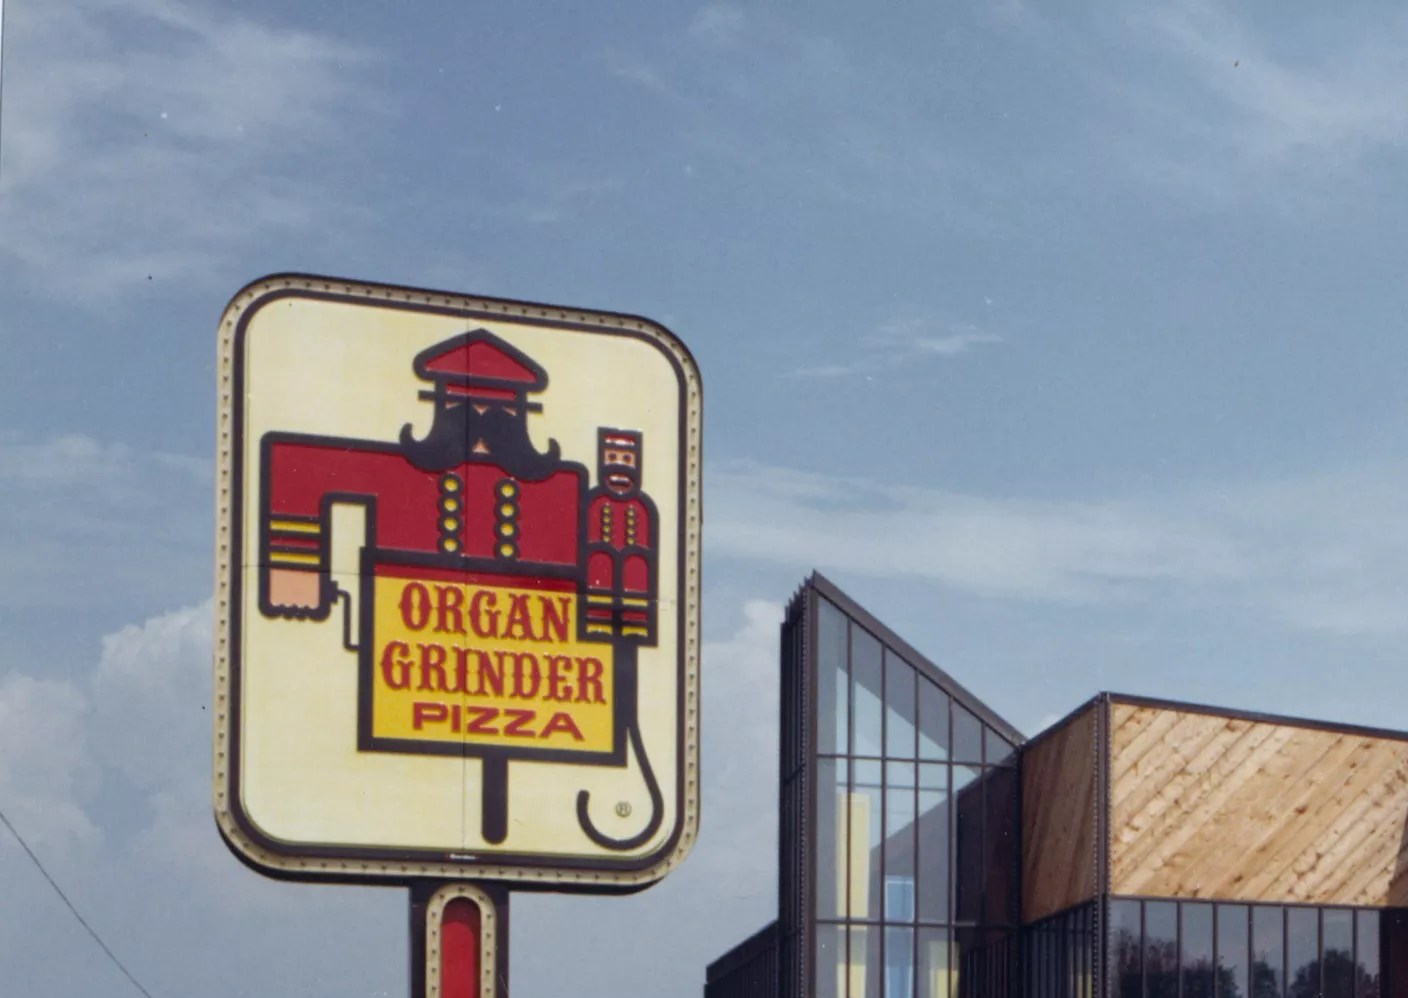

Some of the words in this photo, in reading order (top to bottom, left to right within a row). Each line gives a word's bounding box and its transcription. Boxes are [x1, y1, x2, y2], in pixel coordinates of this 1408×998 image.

[399, 581, 572, 642] ORGAN
[380, 640, 607, 704] GRINDER
[412, 701, 584, 742] PIZZA
